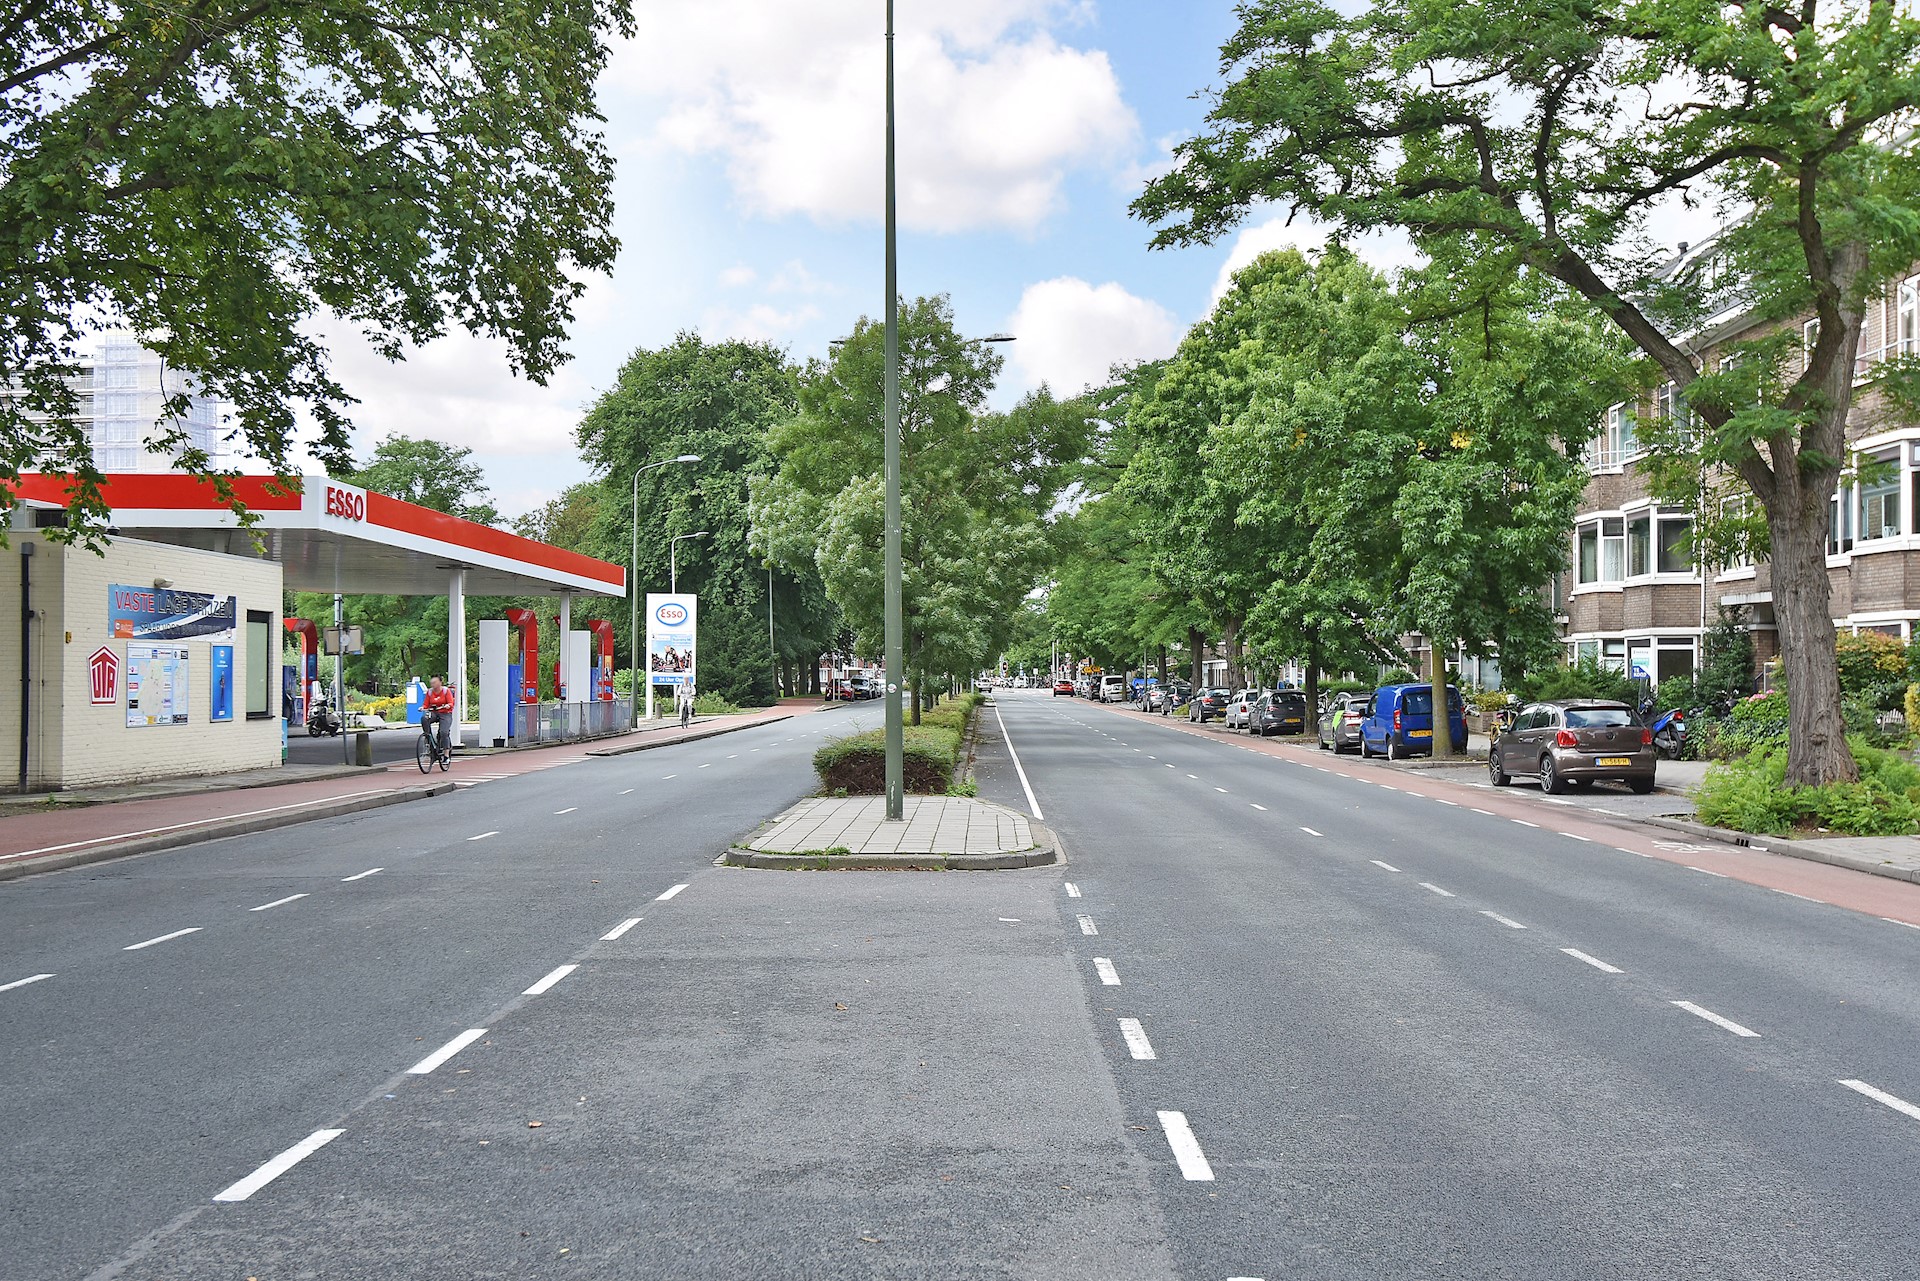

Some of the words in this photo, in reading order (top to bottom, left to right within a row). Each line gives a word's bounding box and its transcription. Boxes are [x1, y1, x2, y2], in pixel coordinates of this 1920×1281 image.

[325, 486, 364, 522] ESSO
[115, 591, 155, 613] VASTE
[158, 594, 188, 615] LAGE
[660, 608, 683, 618] Esso
